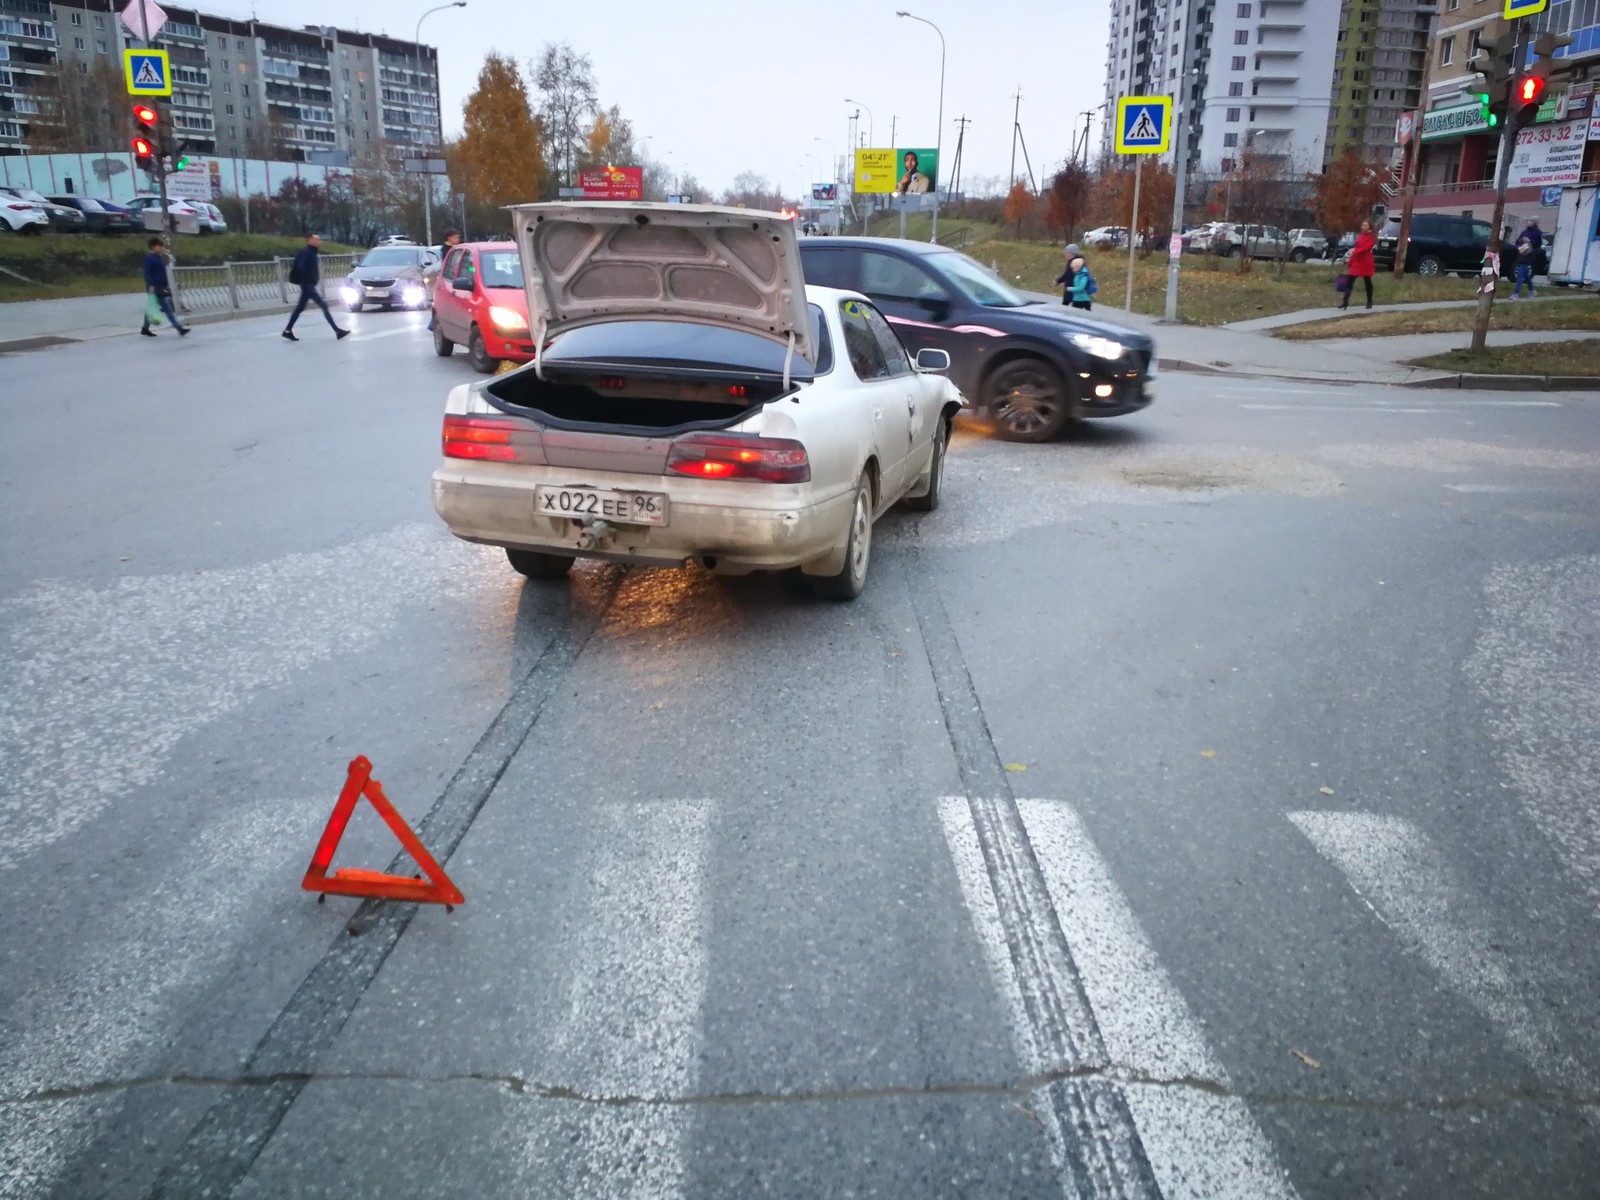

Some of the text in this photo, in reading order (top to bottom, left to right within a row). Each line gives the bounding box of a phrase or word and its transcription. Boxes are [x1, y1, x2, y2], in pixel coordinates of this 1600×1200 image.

[1516, 126, 1571, 146] 272-33-32
[1543, 163, 1580, 173] СПЕЦИАЛИСТЫ
[544, 491, 656, 517] Х022ЕЕ 96
